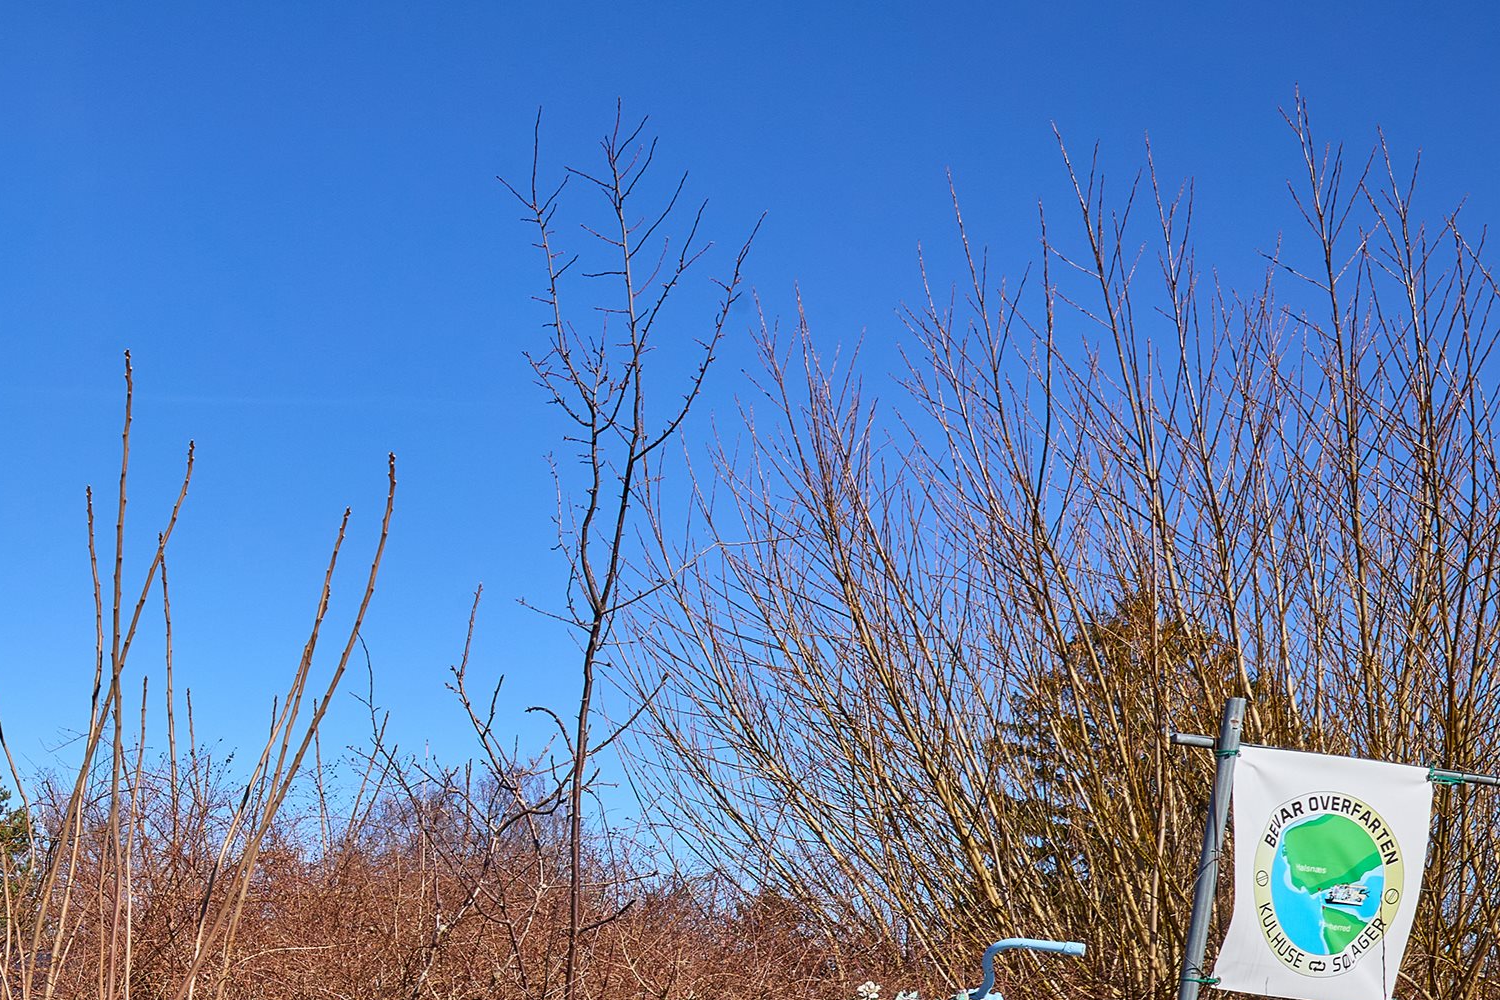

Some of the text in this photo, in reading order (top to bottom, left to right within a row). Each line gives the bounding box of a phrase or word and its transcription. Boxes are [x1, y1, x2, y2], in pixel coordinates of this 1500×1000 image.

[1263, 795, 1399, 866] BEVAR OVERFARTEN
[1259, 902, 1387, 972] KULHUSE SØAGER
